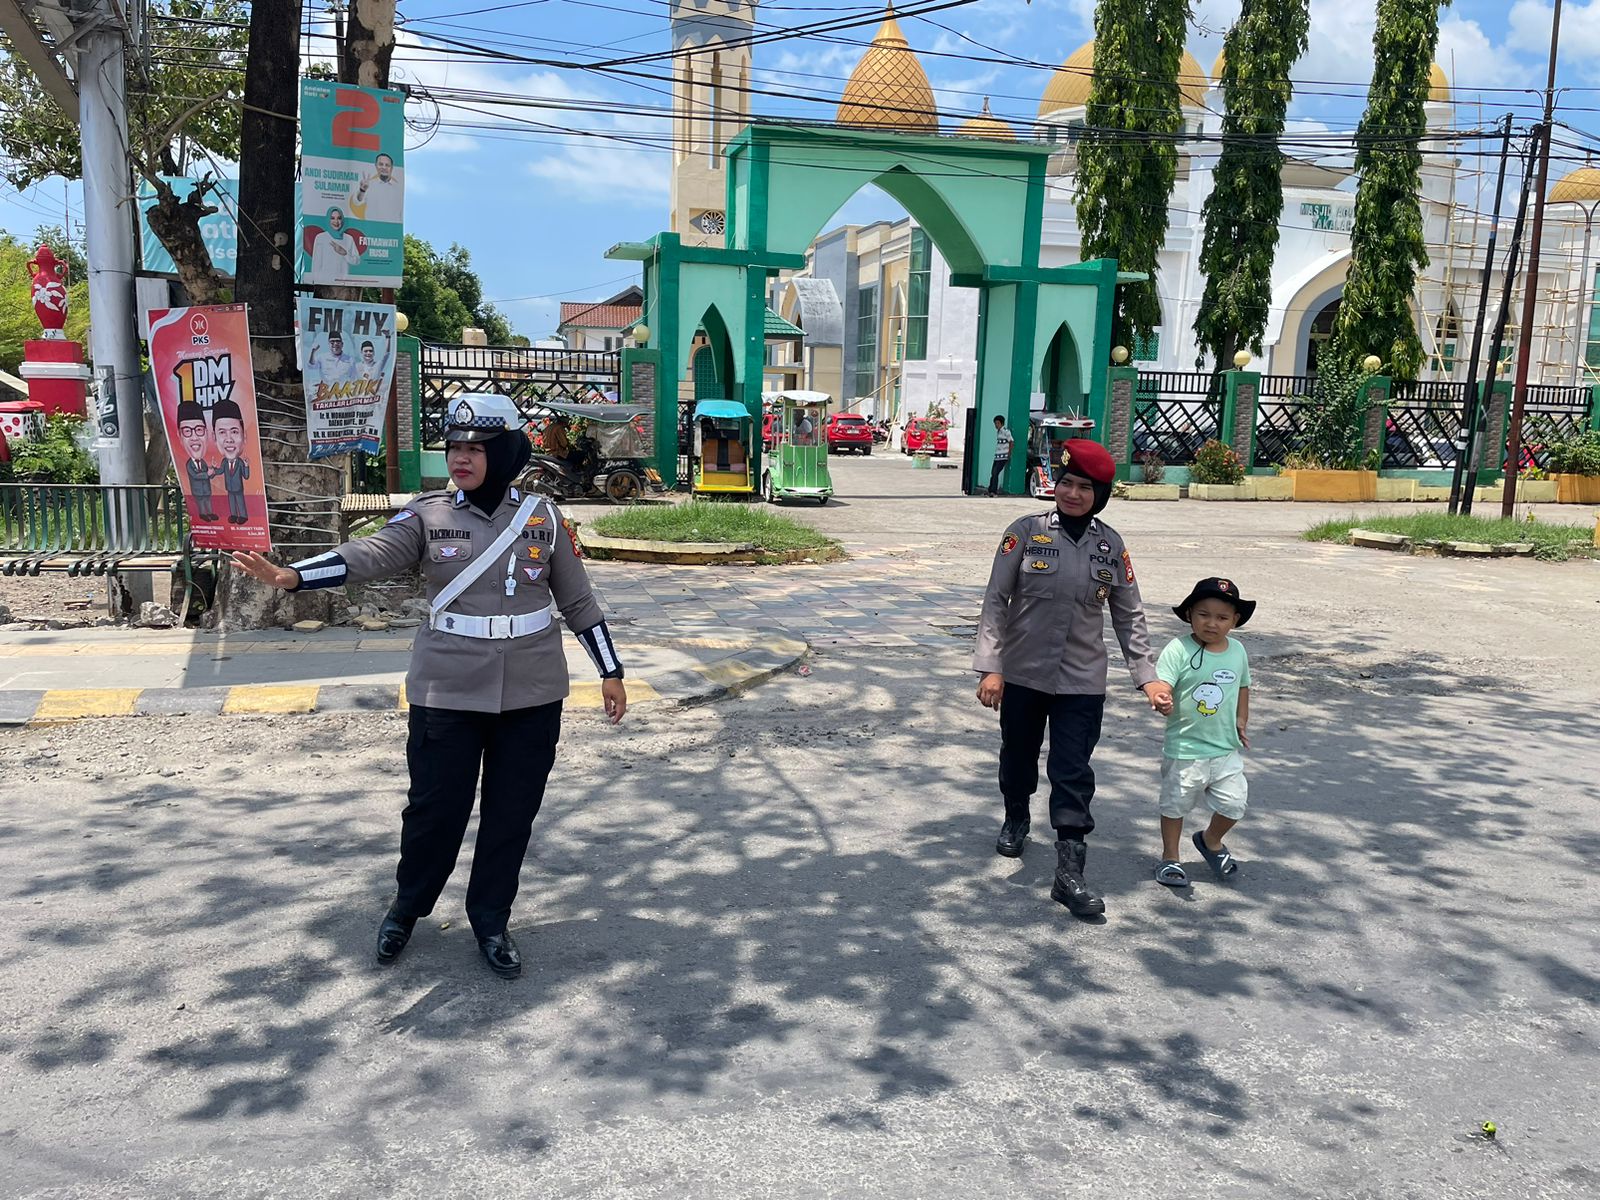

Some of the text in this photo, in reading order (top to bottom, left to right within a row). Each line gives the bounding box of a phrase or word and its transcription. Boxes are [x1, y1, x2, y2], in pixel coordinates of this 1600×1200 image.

[332, 88, 380, 151] 2
[305, 167, 359, 181] ANDI SUDIRMAN
[314, 181, 350, 192] SULAIMAN
[359, 236, 398, 248] FATMAWATI
[308, 307, 389, 336] FM HY
[192, 336, 210, 345] PKS
[193, 356, 230, 387] DM
[176, 362, 194, 401] 1
[195, 384, 231, 407] HHY
[316, 400, 346, 409] TAKALAR
[522, 529, 551, 542] OLRI
[1090, 554, 1119, 568] POLRI
